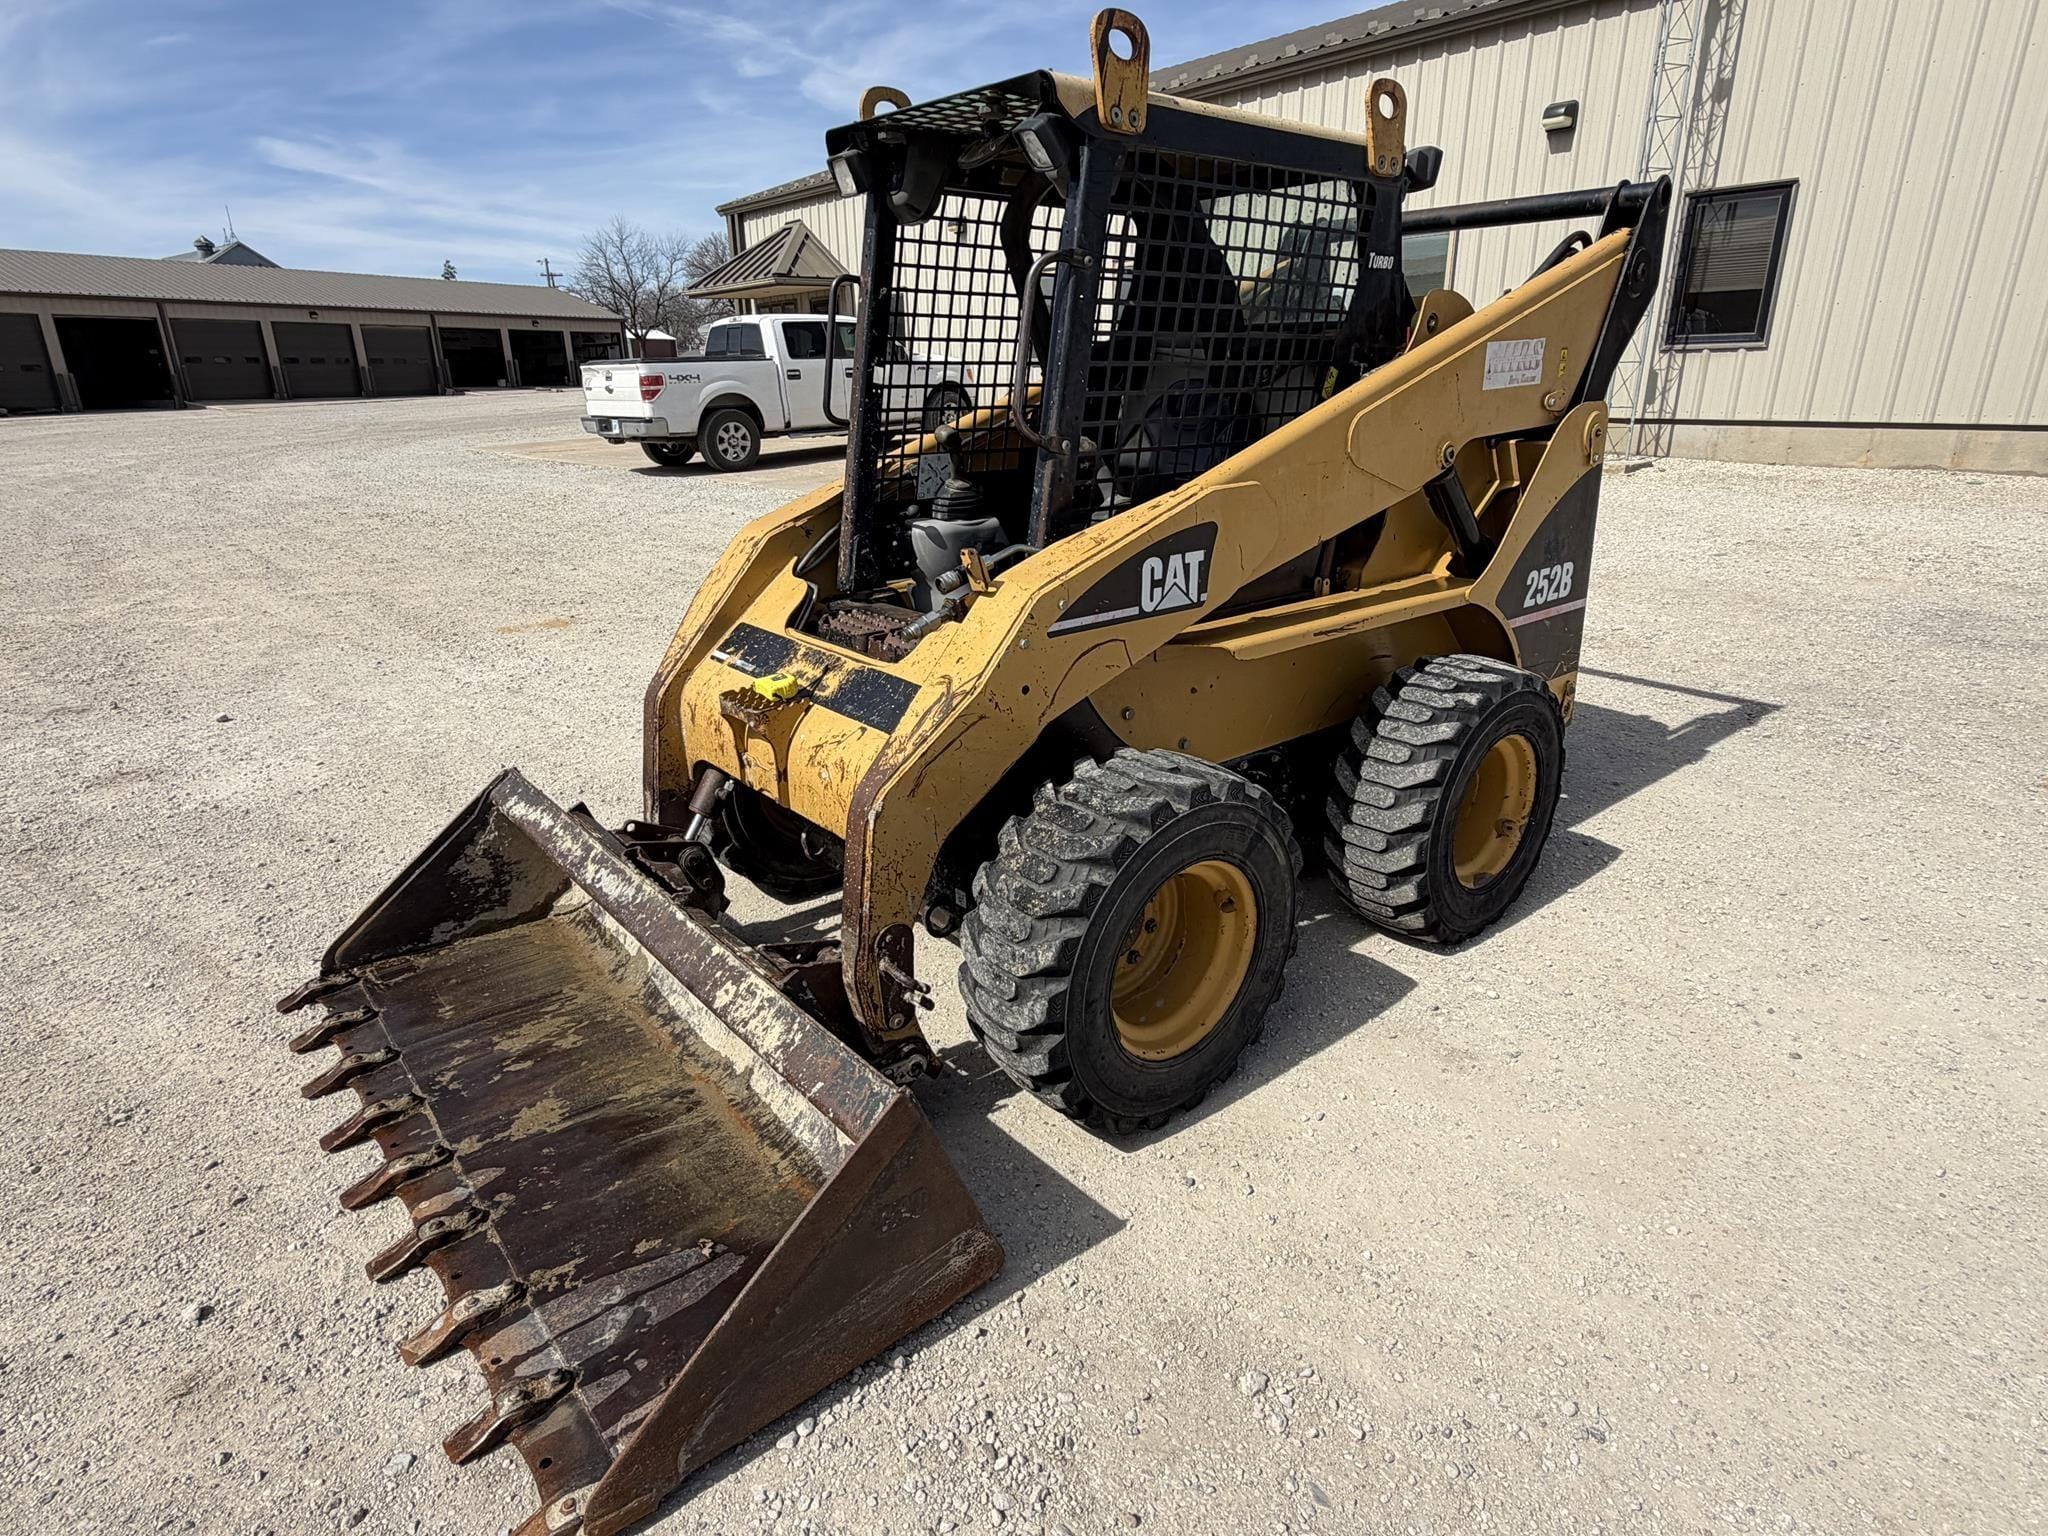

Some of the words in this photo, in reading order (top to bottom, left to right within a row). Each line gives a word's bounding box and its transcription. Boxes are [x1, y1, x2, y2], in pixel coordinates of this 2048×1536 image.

[1368, 252, 1394, 270] TURBO
[1141, 550, 1206, 613] CAT
[1523, 562, 1574, 609] 252B
